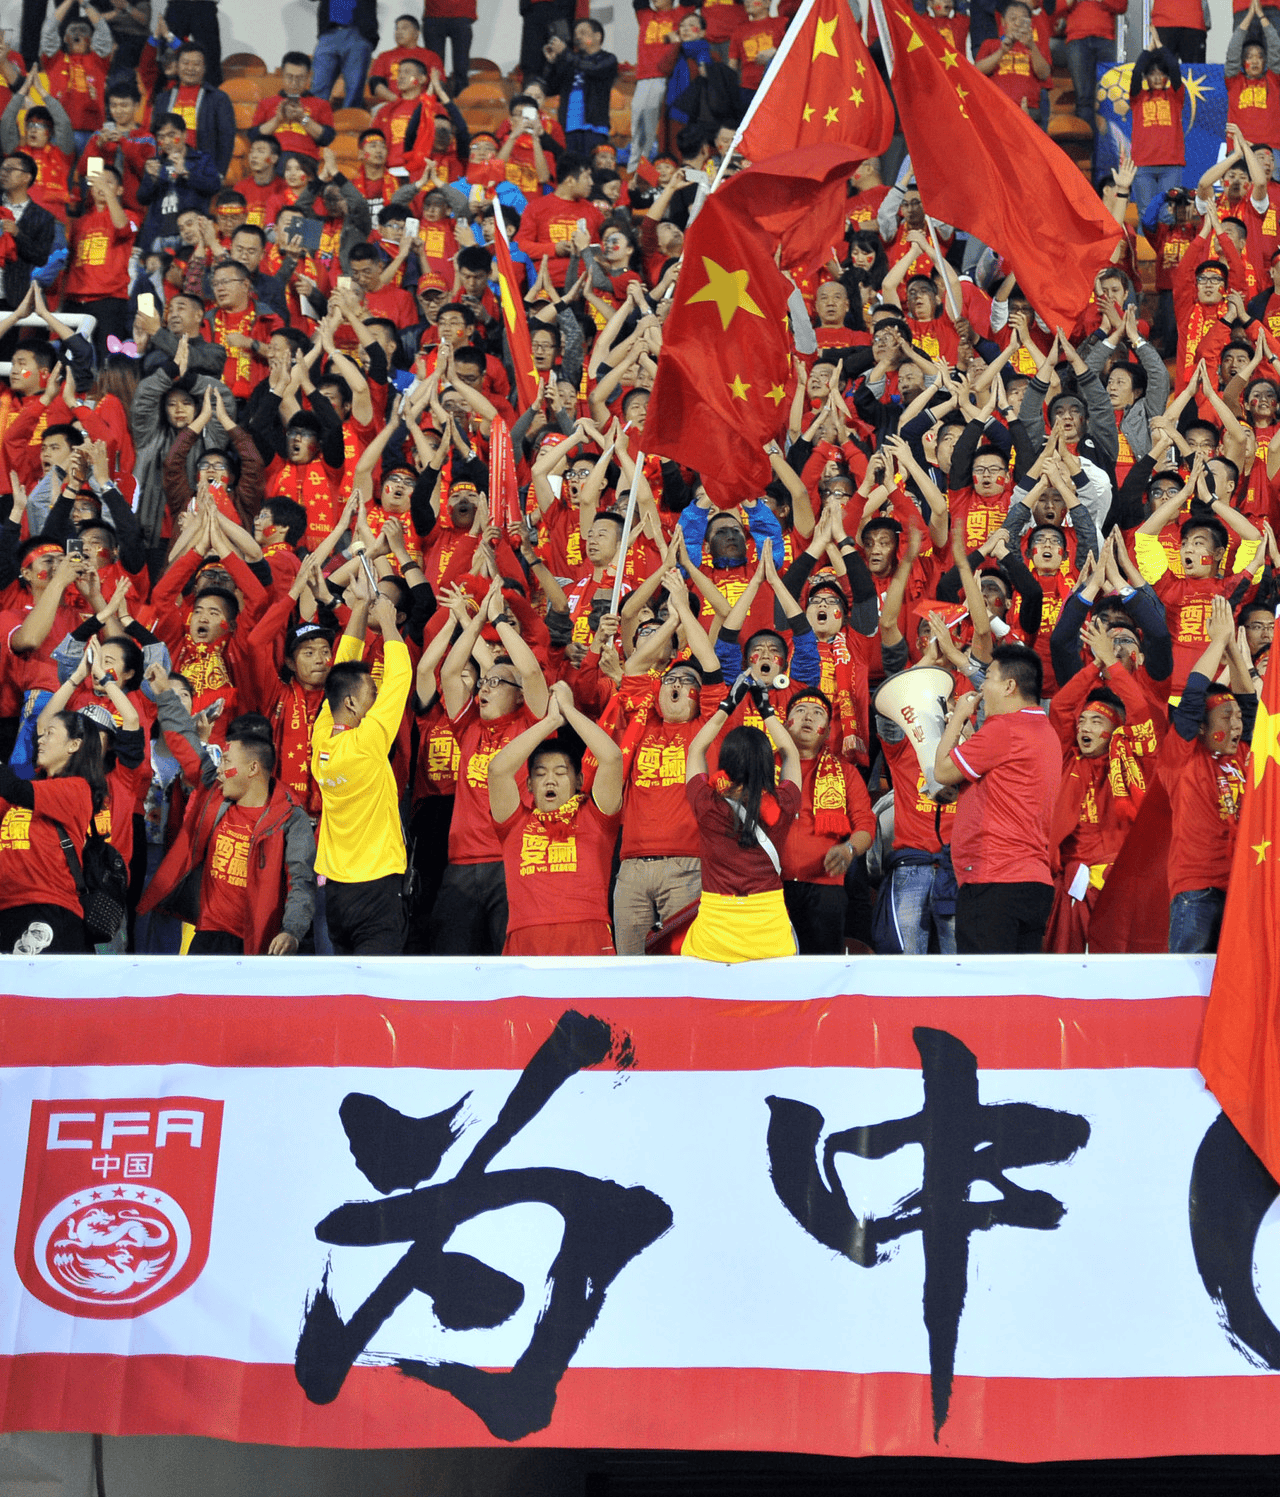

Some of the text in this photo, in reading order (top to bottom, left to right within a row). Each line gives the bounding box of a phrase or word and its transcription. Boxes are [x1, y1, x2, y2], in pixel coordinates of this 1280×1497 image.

[309, 522, 335, 532] CHIN
[520, 833, 578, 866] 要赢
[46, 1109, 205, 1151] CFA
[91, 1153, 153, 1180] 中国
